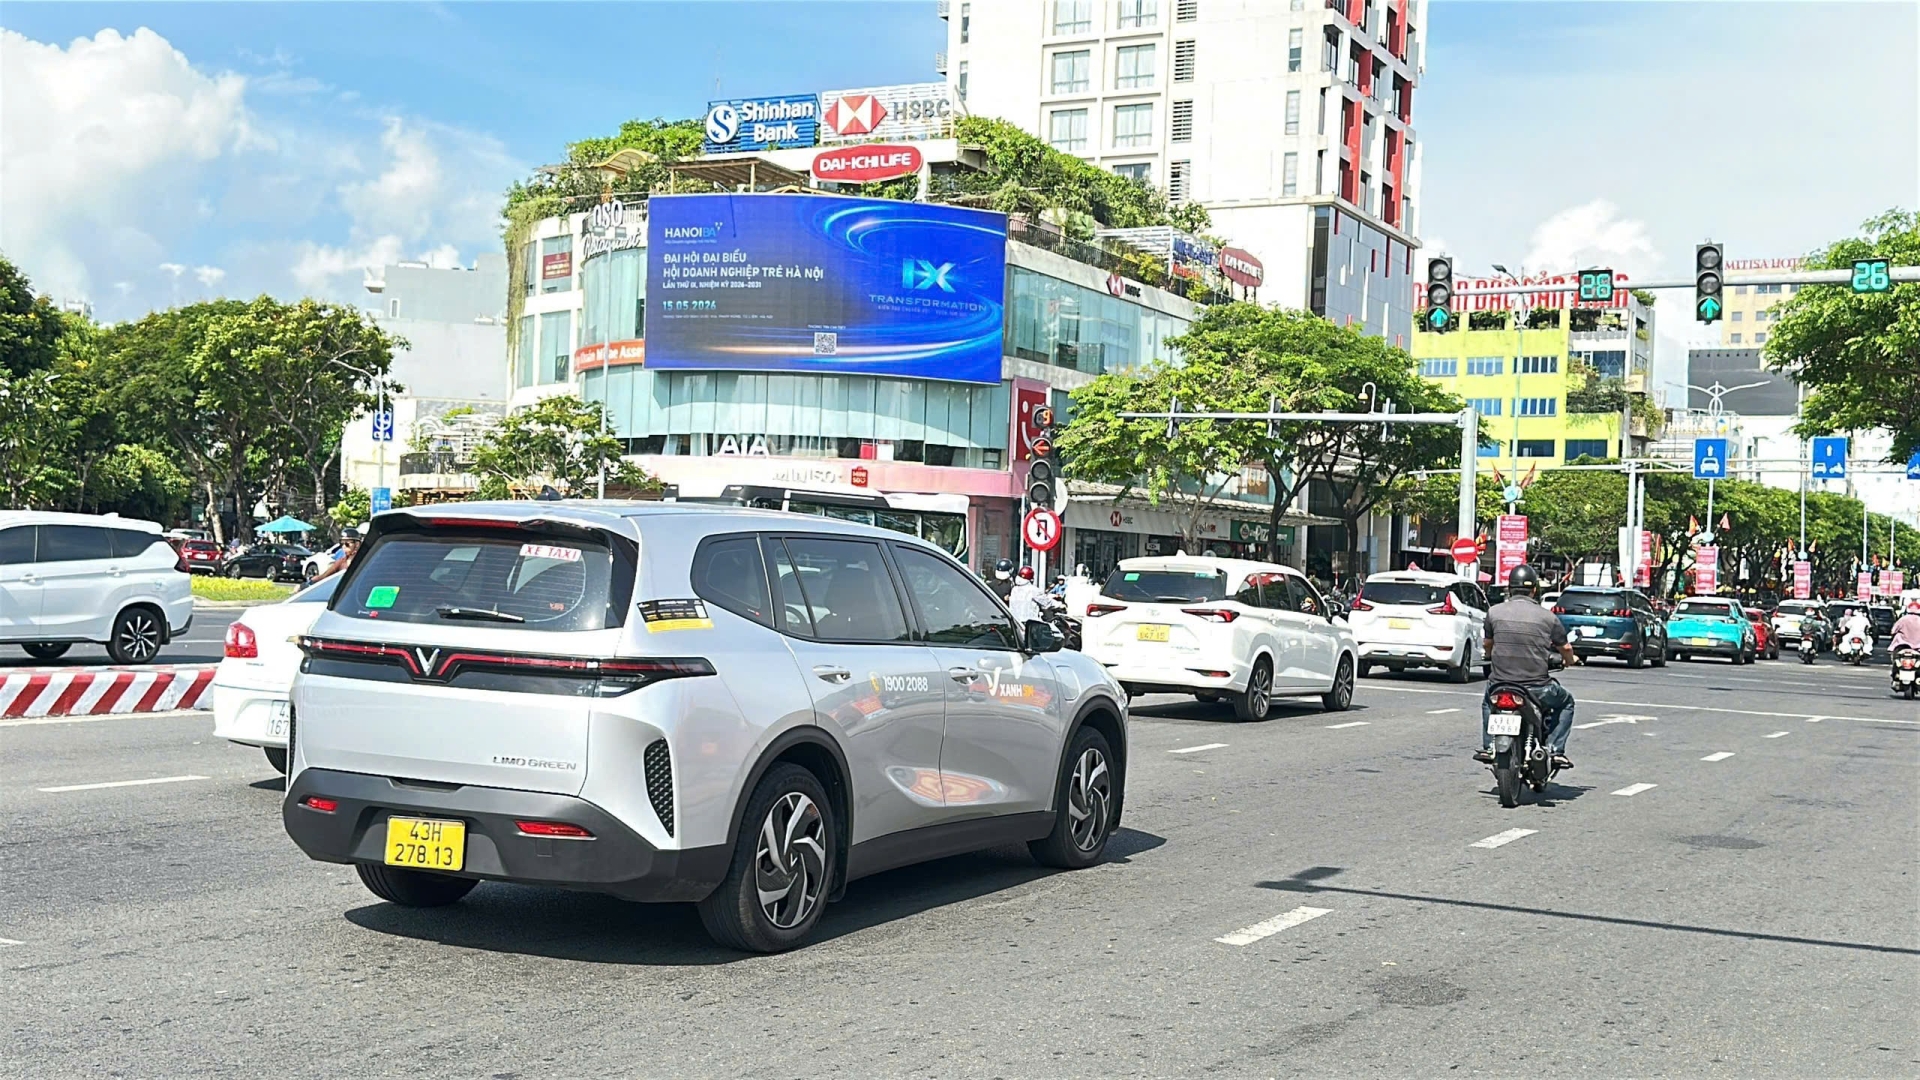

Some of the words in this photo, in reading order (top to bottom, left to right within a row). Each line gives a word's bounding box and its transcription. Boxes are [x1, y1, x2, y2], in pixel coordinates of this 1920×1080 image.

[741, 101, 814, 122] Shinhan
[893, 100, 951, 121] HSBC
[754, 124, 799, 142] Bank
[881, 152, 911, 167] LIFE
[683, 250, 700, 266] HỘI
[1725, 258, 1768, 270] MITISA
[663, 263, 680, 280] HỘI
[682, 266, 718, 278] DOANH
[720, 264, 760, 280] NGHIỆP
[785, 264, 802, 279] HÀ
[804, 266, 824, 282] NỘI
[902, 257, 957, 293] IX
[1852, 261, 1891, 291] 26
[868, 293, 987, 312] TRANSFORMATION
[716, 435, 770, 457] AIA
[526, 545, 542, 556] XE
[548, 547, 578, 560] TAXI
[883, 676, 905, 691] 1900
[906, 676, 928, 692] 2088
[1000, 683, 1022, 697] XANH
[270, 719, 290, 736] 167
[493, 756, 526, 767] LIMO
[527, 759, 577, 770] GREEN
[410, 821, 442, 842] 43H
[395, 843, 453, 866] 278.13
